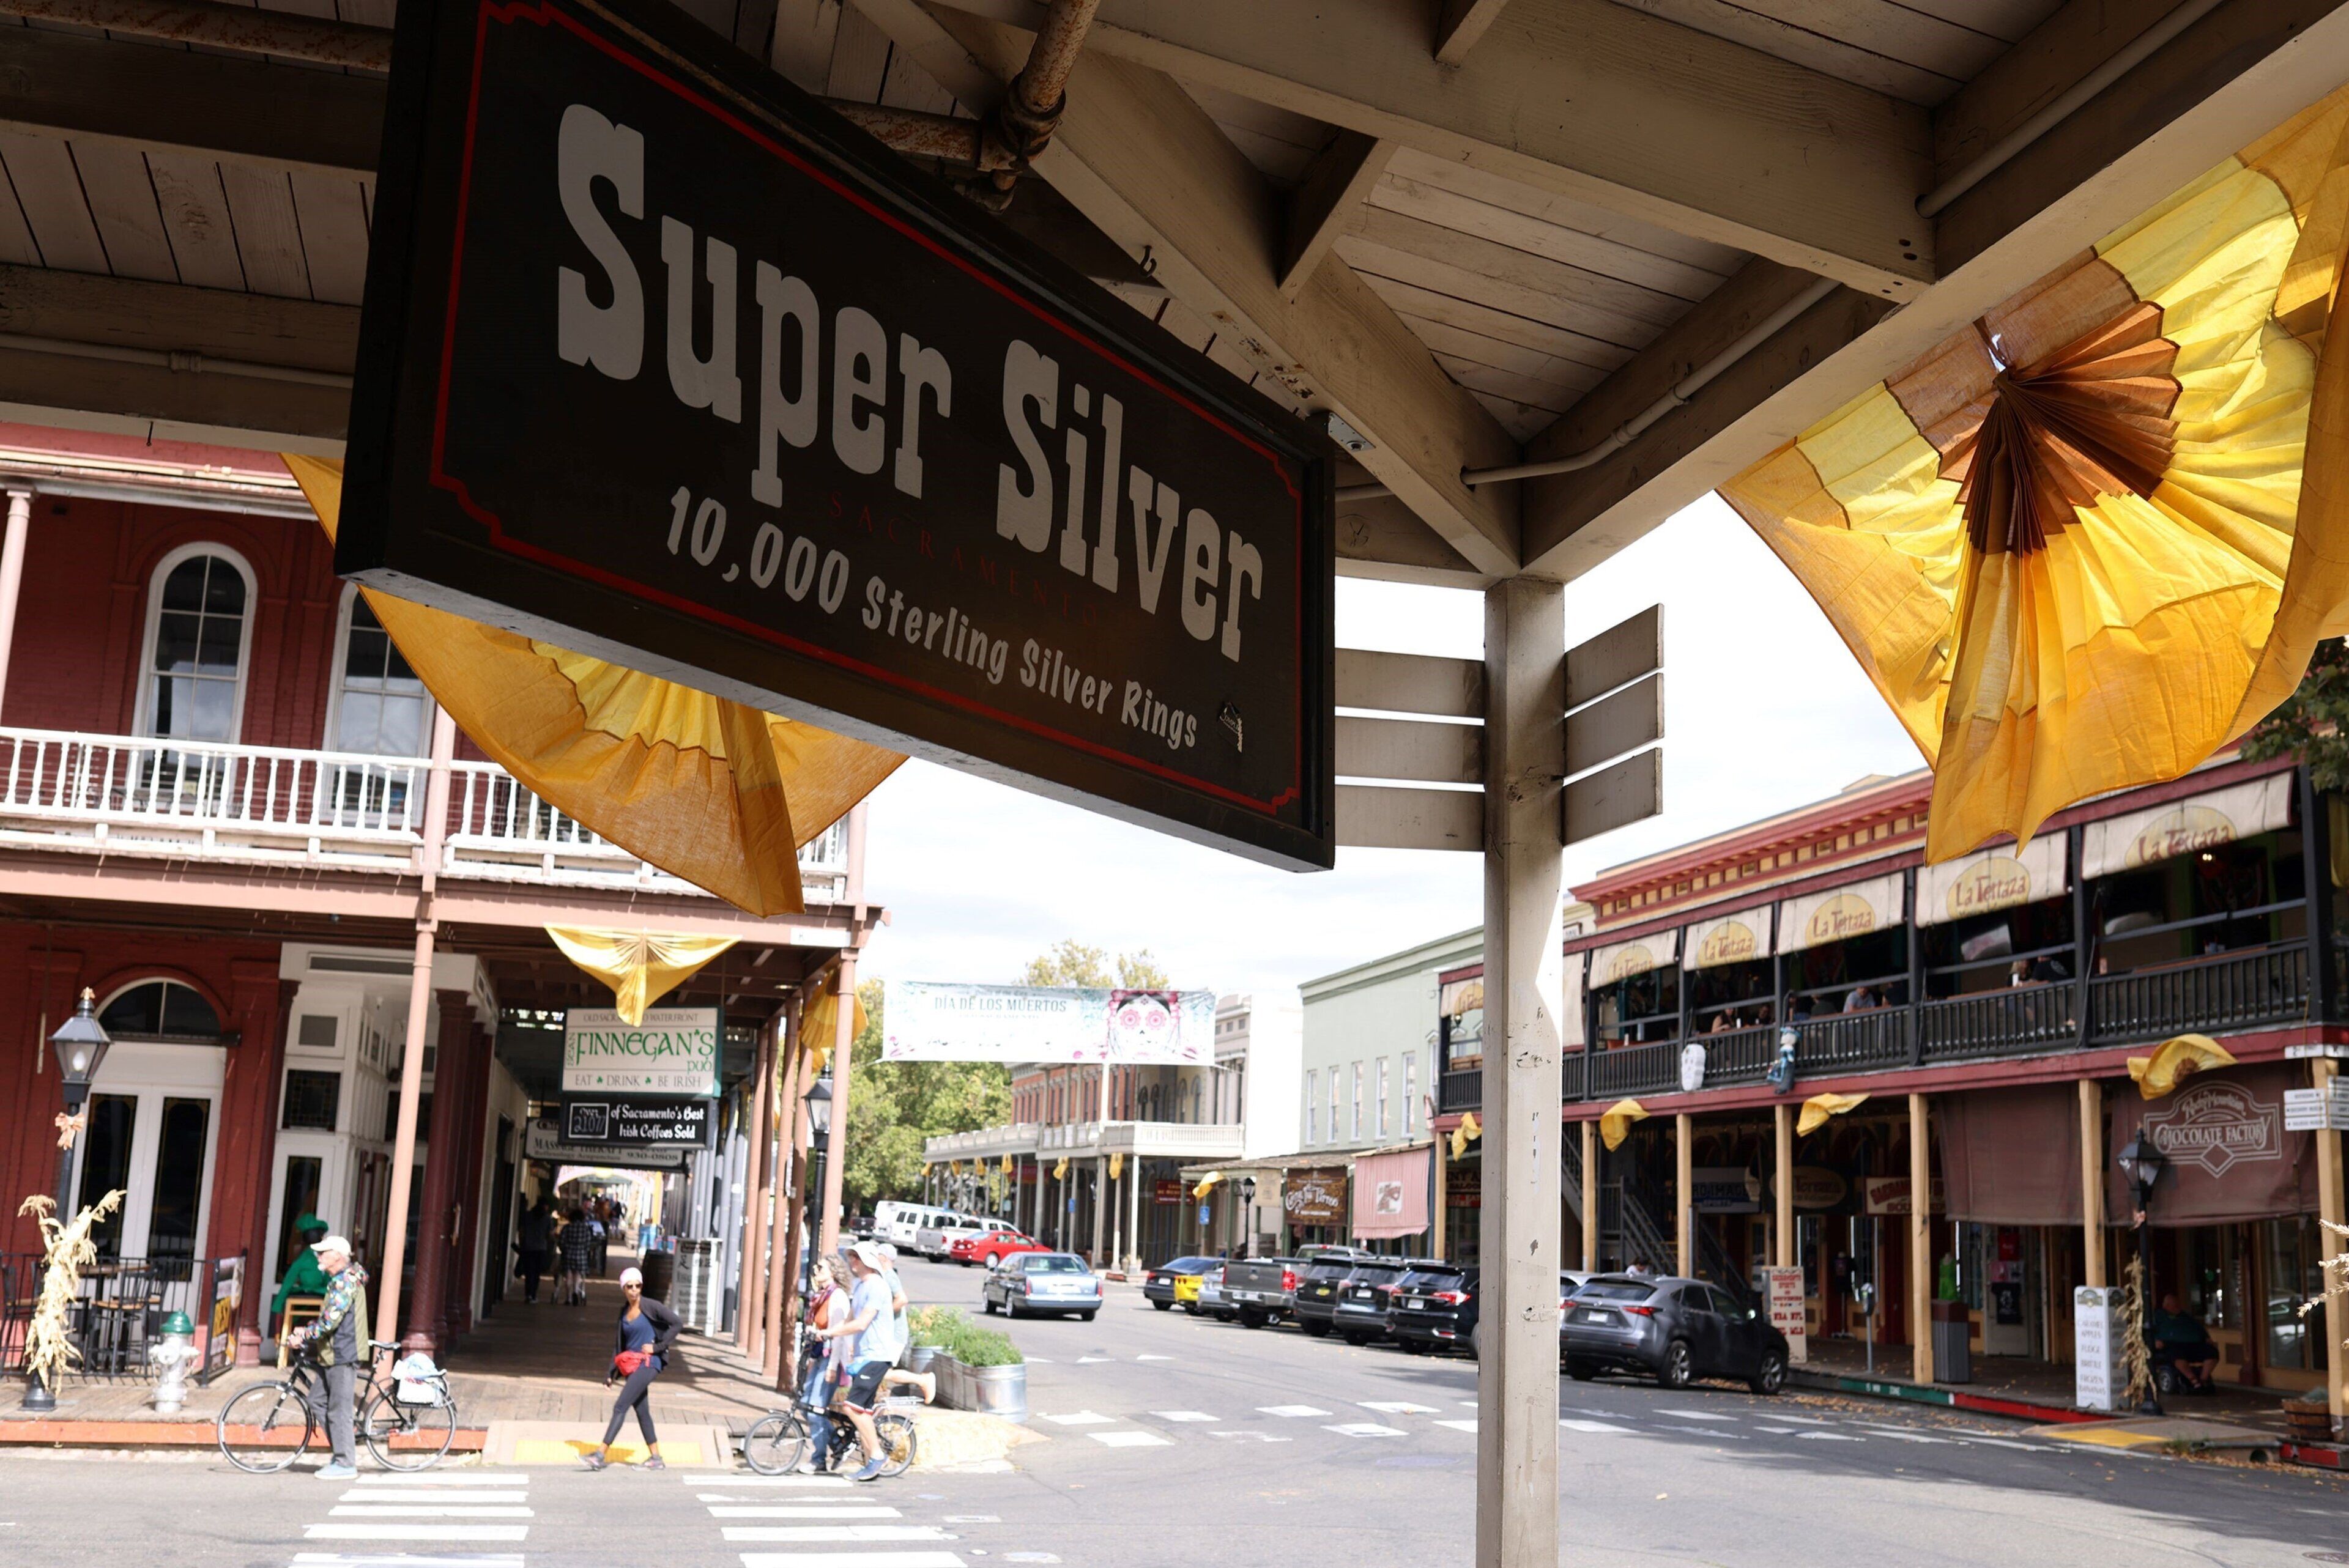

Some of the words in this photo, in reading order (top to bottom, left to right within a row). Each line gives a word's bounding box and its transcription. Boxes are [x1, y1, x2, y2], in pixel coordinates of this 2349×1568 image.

[558, 103, 952, 508] Super
[996, 339, 1263, 663] Silver
[828, 490, 1097, 627] SACRAMENTO
[667, 486, 850, 615] 10,000
[862, 575, 1009, 686] Sterling
[1019, 638, 1113, 716] Silver
[1121, 679, 1198, 750] Rings
[2139, 835, 2161, 863] La
[2165, 824, 2231, 856] Terraza
[1956, 882, 1973, 907] La
[1976, 875, 2027, 902] Terraza
[1813, 916, 1829, 939] La
[1830, 908, 1872, 935] Terraza
[1705, 942, 1716, 961] La
[1717, 936, 1755, 958] Terraza
[583, 1013, 599, 1022] OLD
[650, 1013, 699, 1023] WATERFRONT
[934, 993, 956, 1010] DÍA
[960, 997, 976, 1010] DE
[979, 998, 1003, 1011] LOS
[1007, 999, 1067, 1013] MUERTOS
[576, 1029, 714, 1067] FINNEGAN'S
[575, 1074, 593, 1086] EAT
[606, 1075, 640, 1087] DRINK
[657, 1075, 669, 1087] BE
[674, 1075, 701, 1087] IRISH
[686, 1056, 713, 1074] pub
[610, 1104, 620, 1120] of
[622, 1104, 682, 1120] Sacramento's
[683, 1106, 704, 1121] Best
[619, 1123, 638, 1138] Irish
[639, 1124, 673, 1140] Coffees
[674, 1124, 696, 1139] Sold
[2154, 1124, 2224, 1154] CHOCOLATE
[2225, 1115, 2272, 1150] FACTORY
